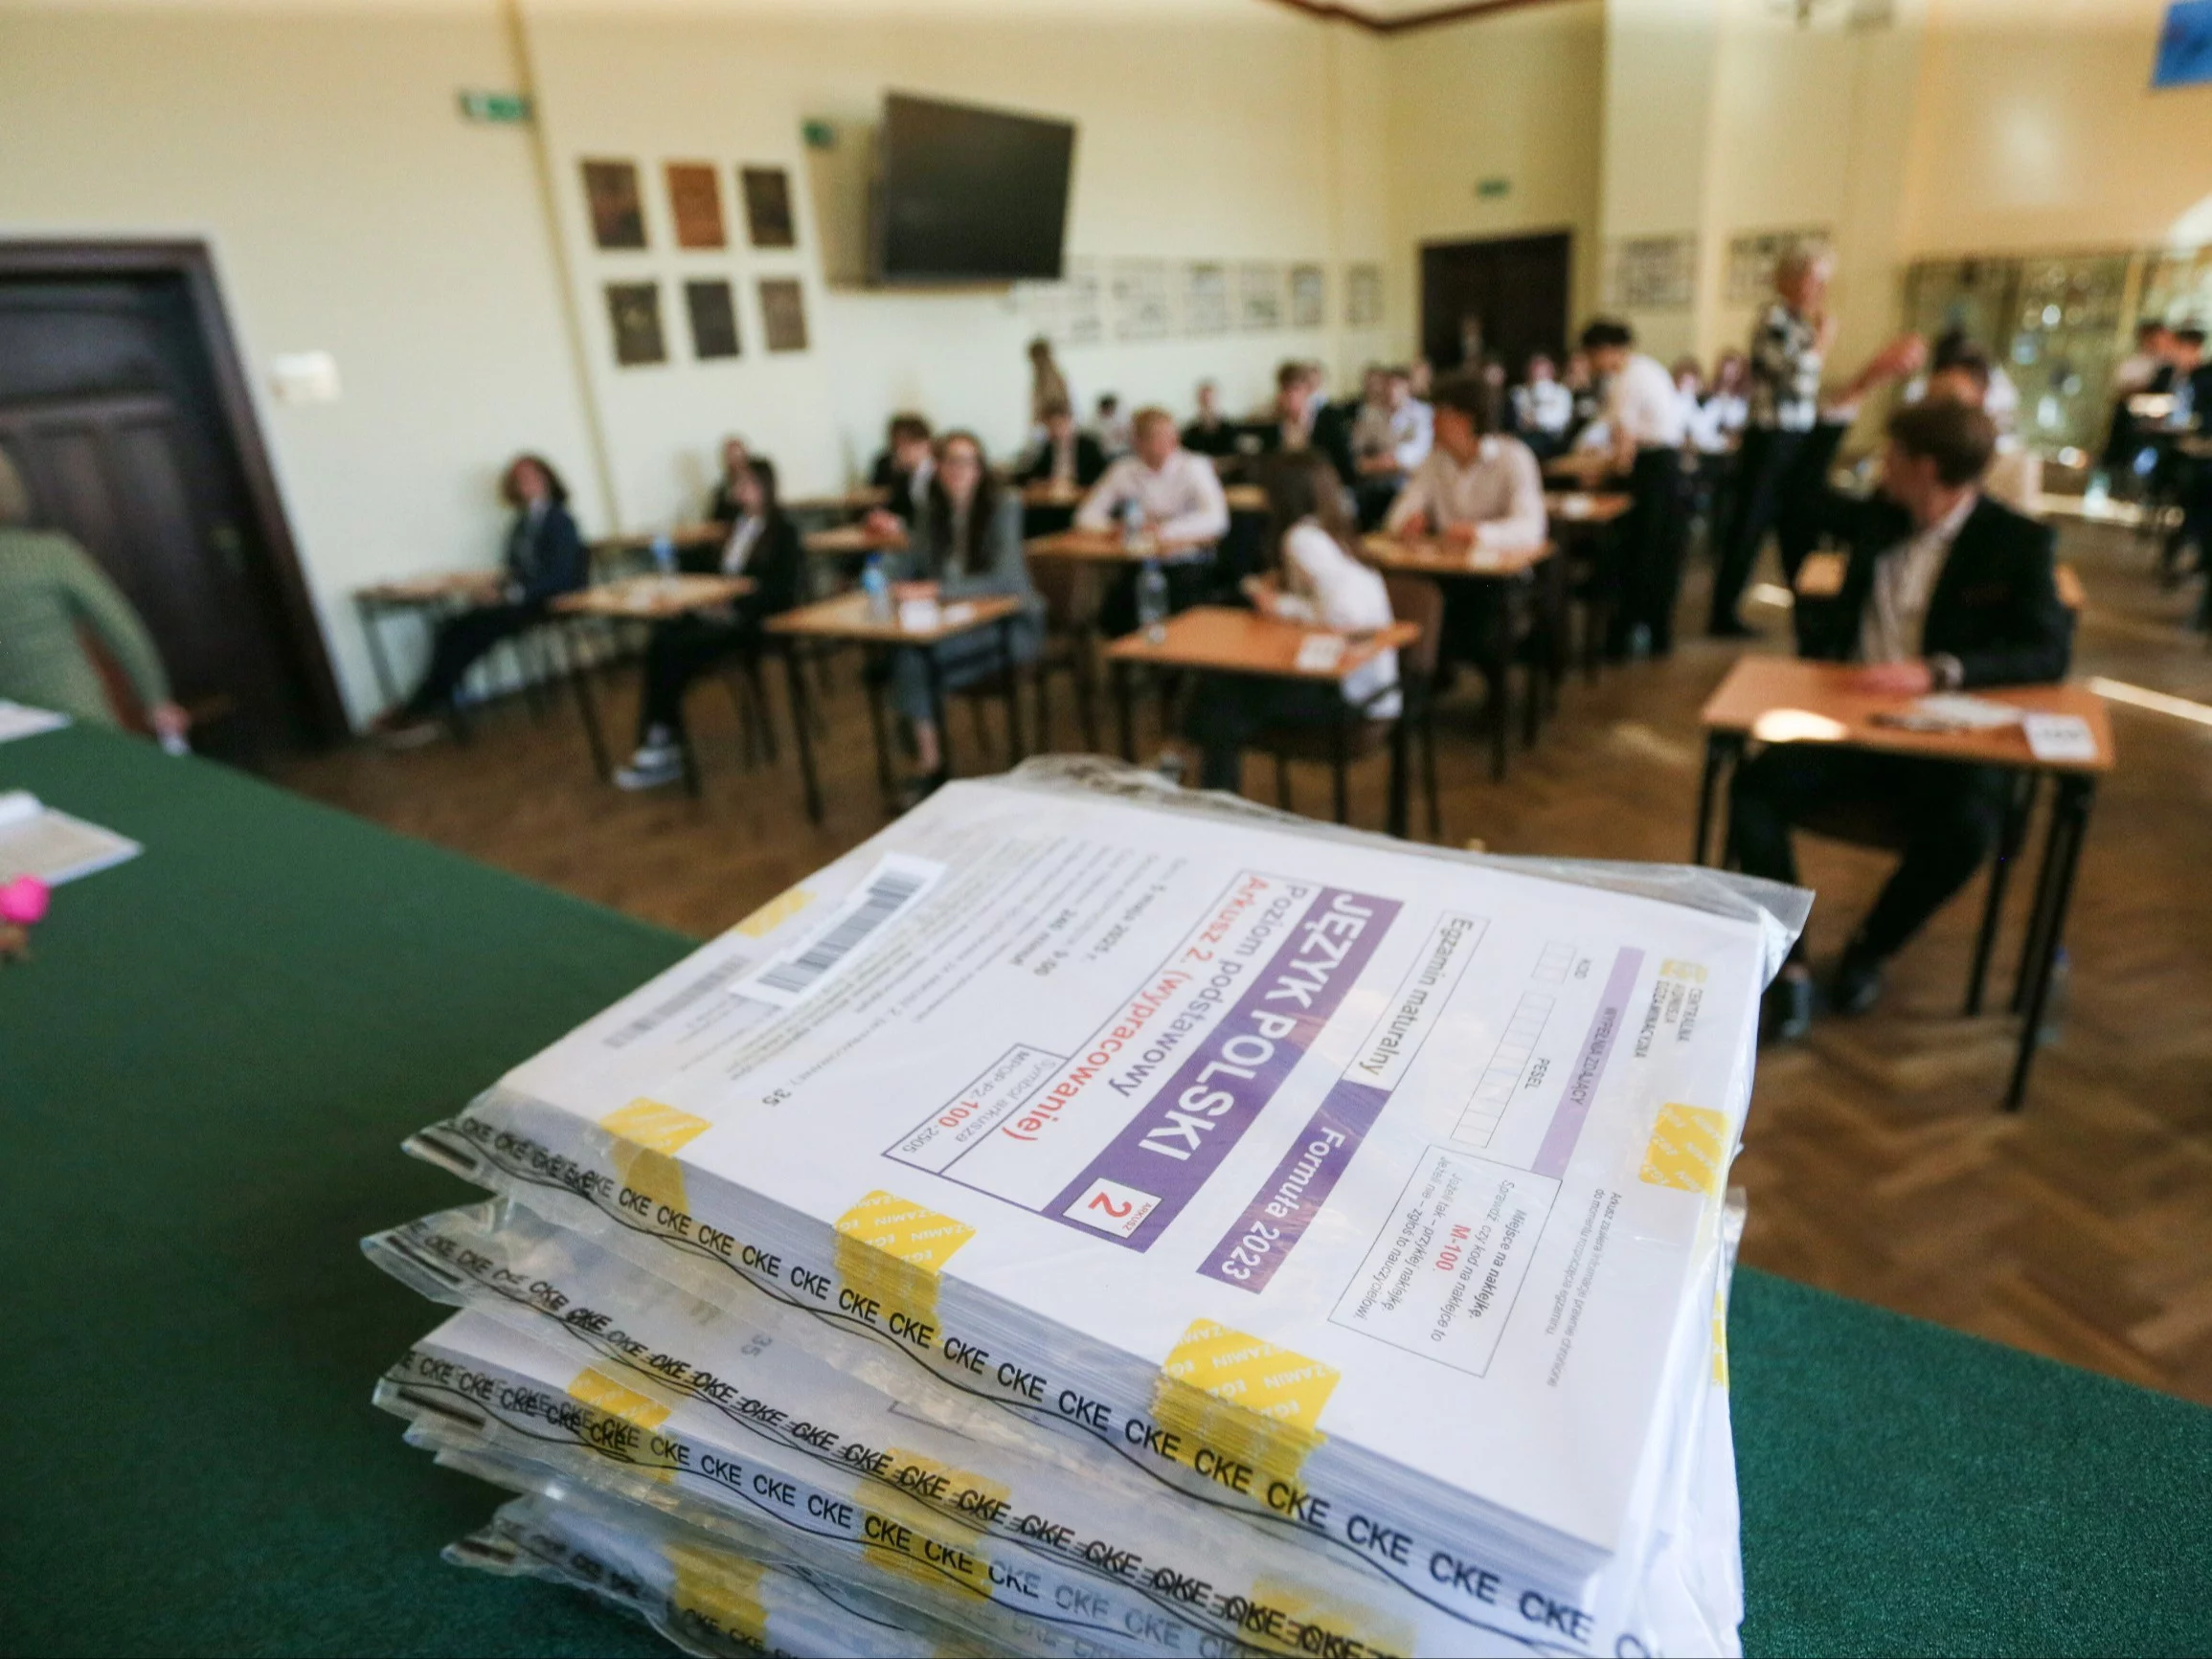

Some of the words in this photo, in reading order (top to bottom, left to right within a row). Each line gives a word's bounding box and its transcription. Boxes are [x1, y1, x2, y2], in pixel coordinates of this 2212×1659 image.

[1196, 876, 1272, 944] Arkusz
[1231, 885, 1311, 956] Poziom
[1179, 946, 1215, 964] 2.
[1258, 892, 1378, 1007] JĘZYK
[1416, 918, 1475, 986] Egzamin
[1105, 960, 1245, 1098] podstawowy
[1357, 989, 1431, 1075] maturalny
[1001, 975, 1182, 1142] (wypracowanie)
[1005, 1059, 1057, 1100] Symbol
[1524, 1058, 1549, 1089] PESEL
[760, 1088, 792, 1106] 35
[1140, 1010, 1296, 1160] POLSKI
[954, 1099, 1009, 1144] arkusza
[1263, 1126, 1346, 1223] Formuła
[1087, 1192, 1134, 1219] 2
[1121, 1202, 1152, 1234] ARKUSZ
[1401, 1207, 1423, 1236] zgłoś
[1433, 1201, 1448, 1218] tak
[1219, 1220, 1281, 1281] 2023
[1396, 1236, 1409, 1247] to
[1404, 1225, 1434, 1267] przyklej
[1474, 1224, 1492, 1244] czy
[1499, 1209, 1526, 1250] Miejsce
[1459, 1266, 1474, 1281] na
[1466, 1244, 1485, 1267] kod
[1493, 1251, 1506, 1267] na
[1354, 1247, 1402, 1319] nauczycielowi.
[1436, 1281, 1467, 1329] naklejce
[1467, 1267, 1501, 1318] naklejkę.
[1430, 1329, 1445, 1341] to
[620, 1188, 652, 1217] CKE
[657, 1206, 691, 1235] CKE
[698, 1225, 734, 1256] CKE
[742, 1245, 781, 1277] CKE
[791, 1267, 831, 1300] CKE
[839, 1289, 880, 1324] CKE
[889, 1312, 935, 1349] CKE
[943, 1337, 989, 1375] CKE
[997, 1362, 1047, 1402] CKE
[1059, 1390, 1111, 1431] CKE
[1125, 1419, 1182, 1462] CKE
[1195, 1448, 1253, 1494] CKE
[1267, 1482, 1331, 1529] CKE
[1347, 1514, 1413, 1565] CKE
[1430, 1552, 1501, 1604] CKE
[1519, 1590, 1595, 1646] CKE
[692, 1371, 738, 1404] CKE
[741, 1399, 788, 1428] CKE
[791, 1422, 840, 1452] CKE
[844, 1444, 894, 1476] CKE
[899, 1465, 951, 1501] CKE
[959, 1489, 1011, 1525] CKE
[1021, 1513, 1075, 1551] CKE
[1084, 1540, 1142, 1578] CKE
[650, 1436, 690, 1466] CKE
[701, 1454, 742, 1486] CKE
[754, 1473, 797, 1506] CKE
[807, 1494, 854, 1529] CKE
[864, 1515, 914, 1551] CKE
[924, 1539, 973, 1575] CKE
